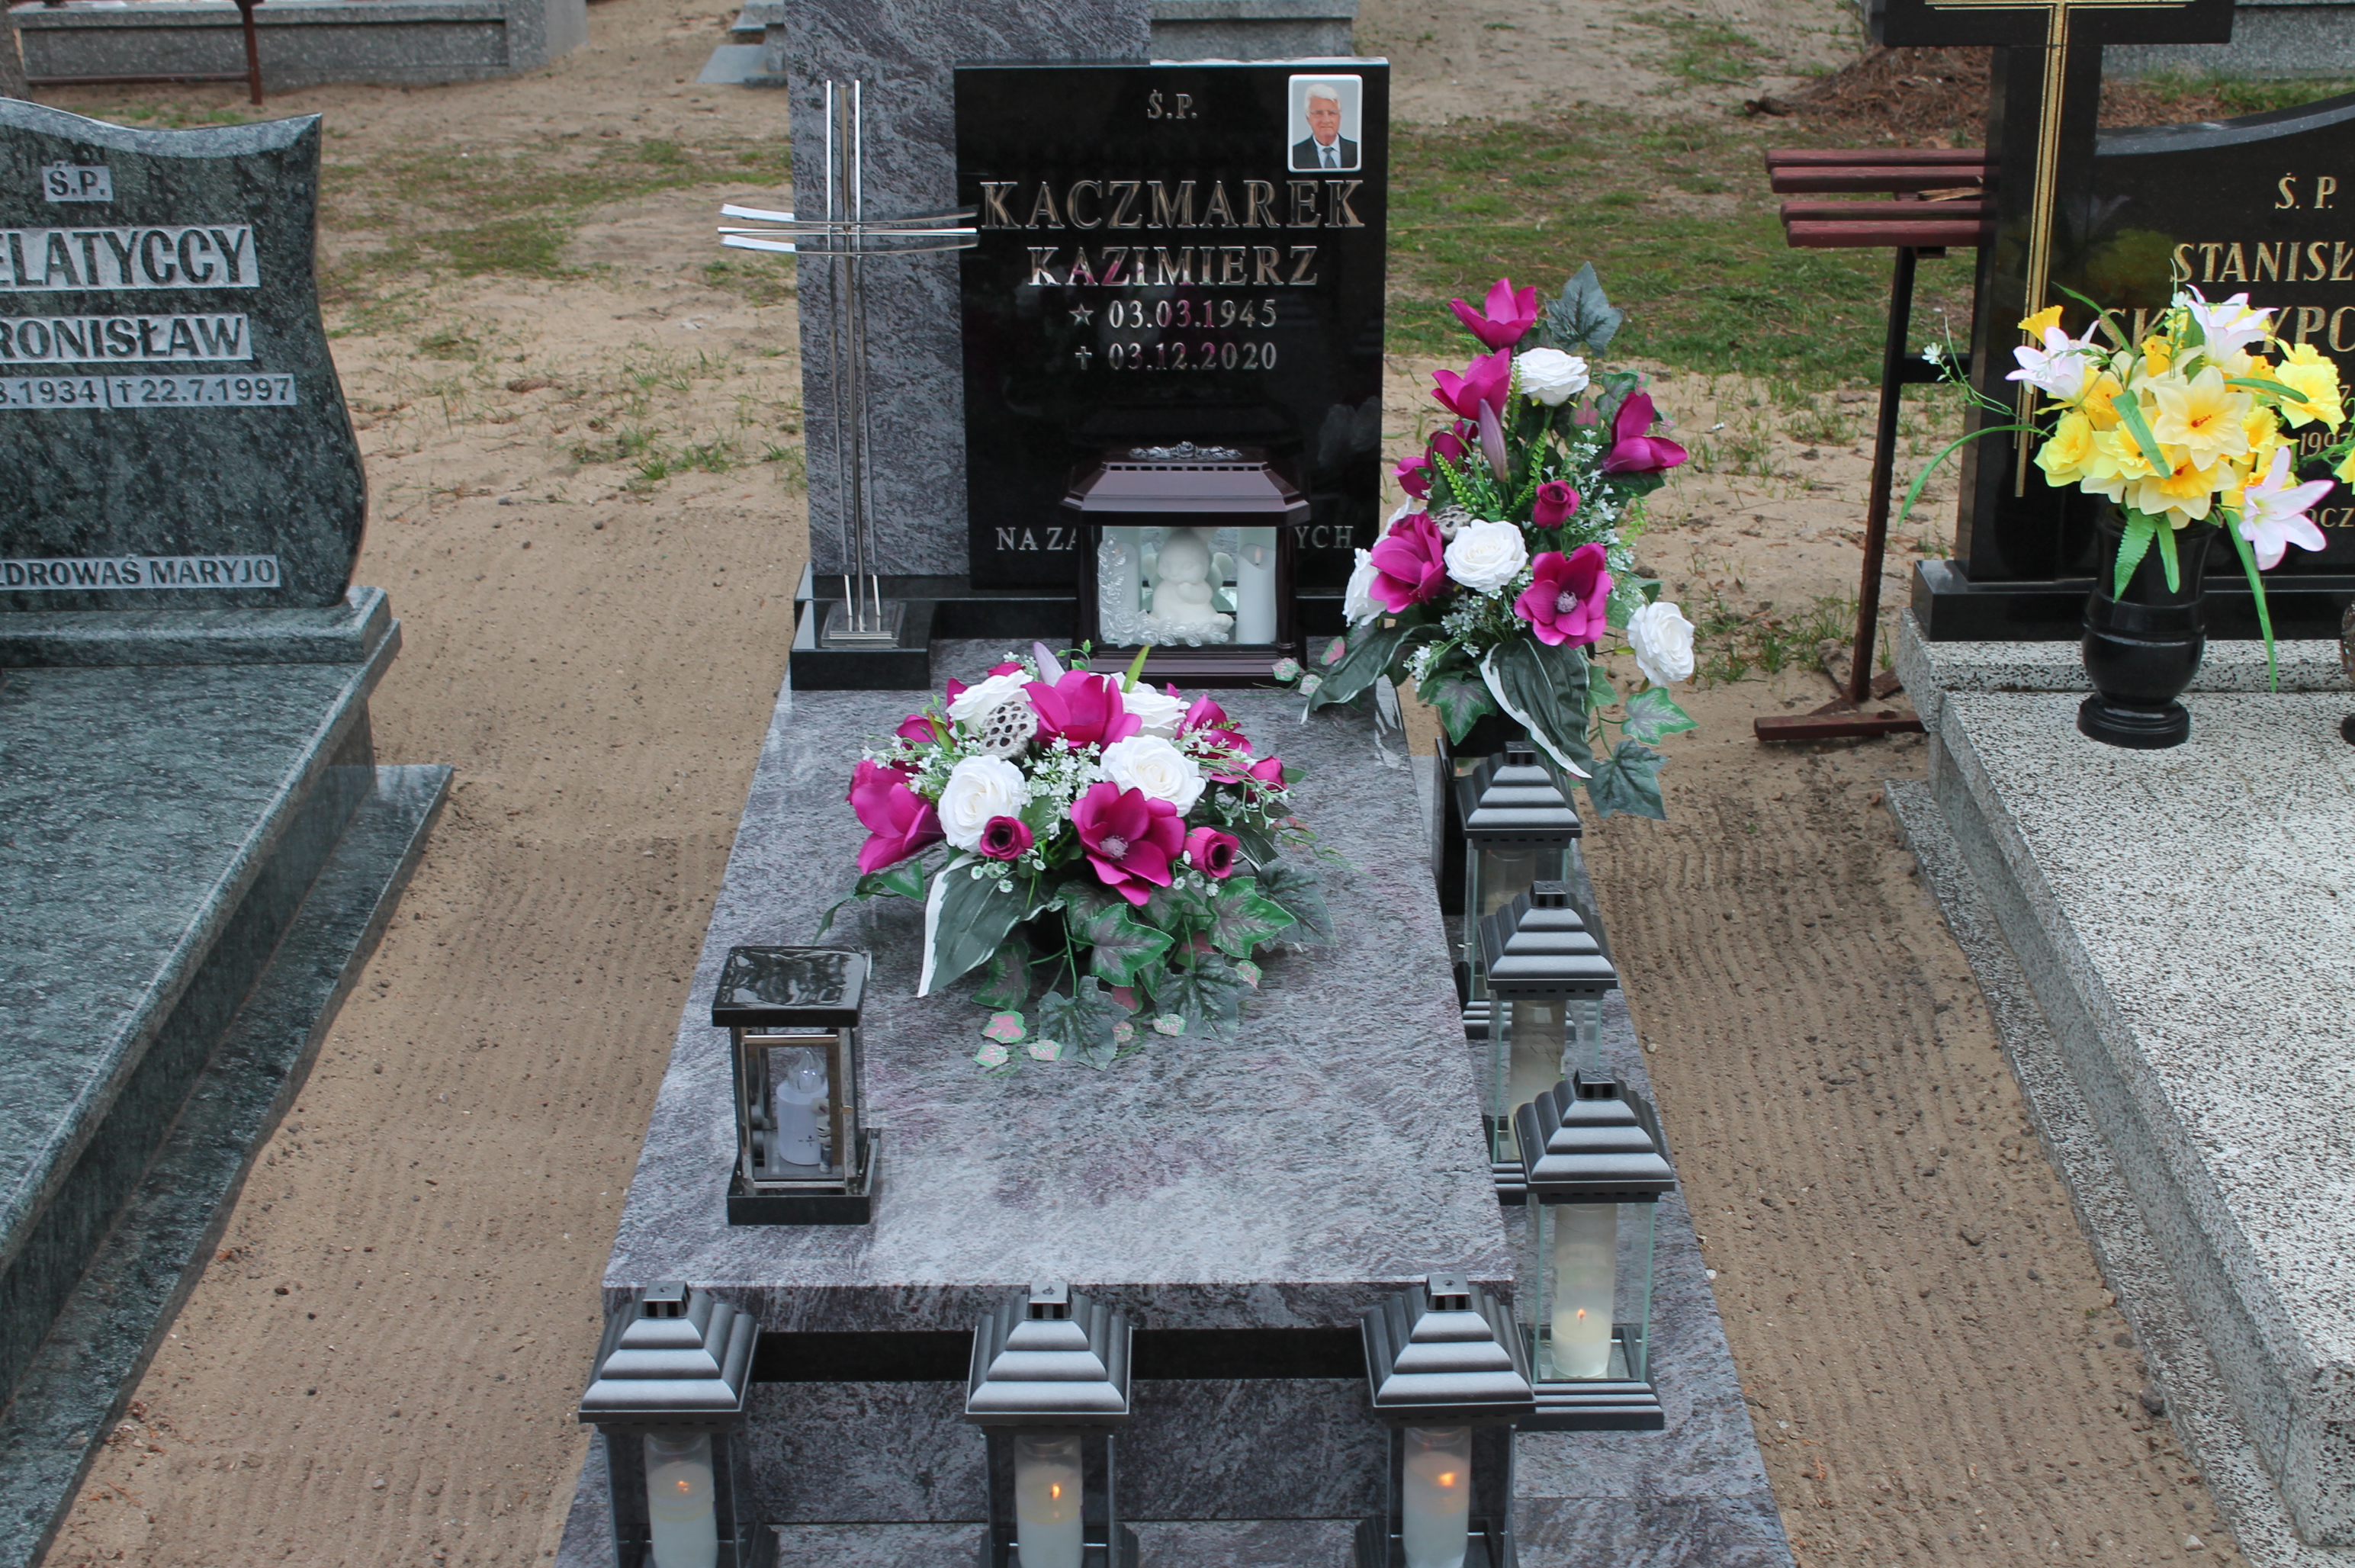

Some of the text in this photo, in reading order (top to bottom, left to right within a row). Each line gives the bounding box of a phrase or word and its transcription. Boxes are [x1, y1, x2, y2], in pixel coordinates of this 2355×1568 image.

[1147, 89, 1198, 119] Ś.P.
[49, 163, 105, 196] Ś.P.
[979, 179, 1365, 229] KACZMAREK
[1026, 246, 1318, 287] KAZIMIERZ
[1108, 298, 1277, 329] 03.03.1945
[1108, 342, 1277, 371] 03.12.2020
[141, 378, 291, 403] 22.7.1997
[0, 555, 276, 586] DROWAŚ MARYJO
